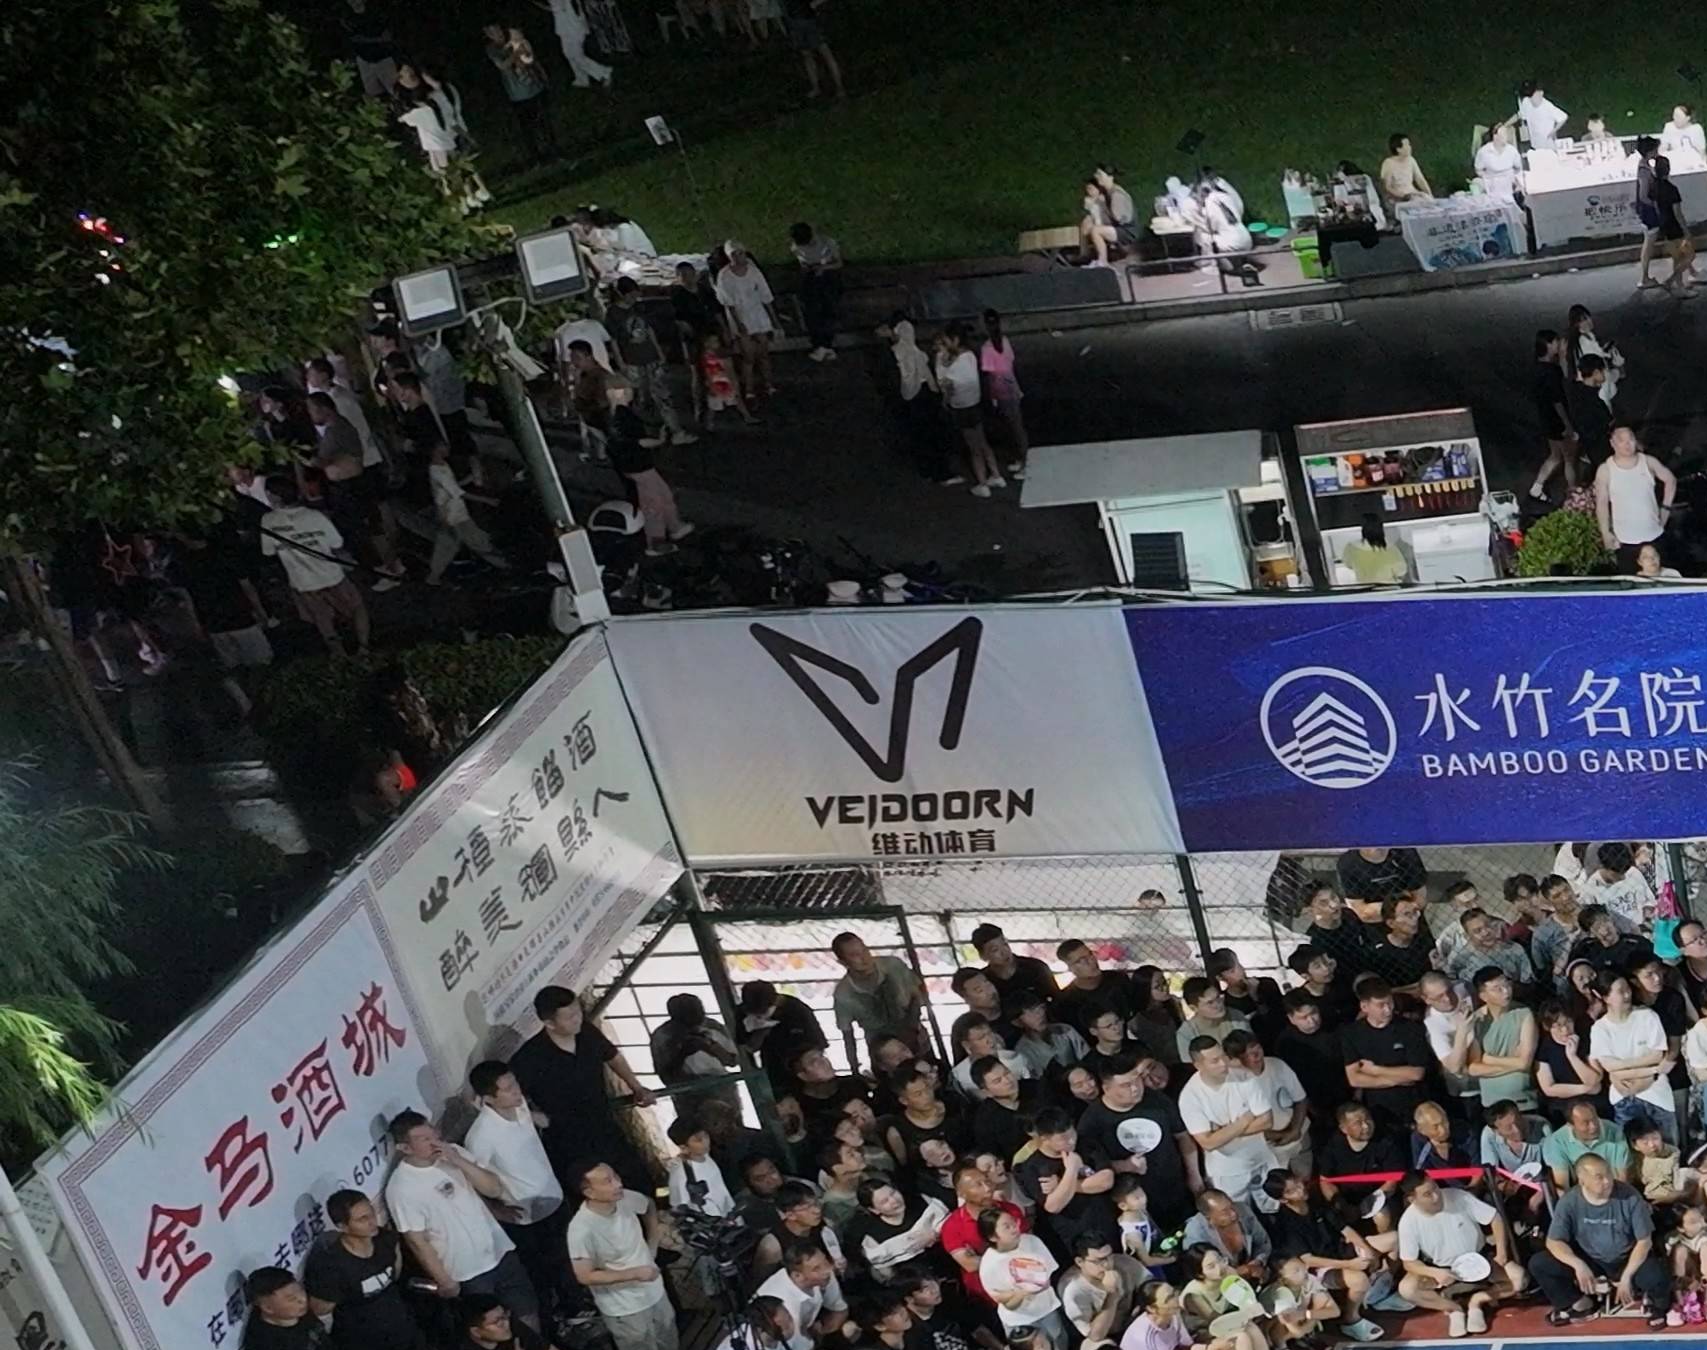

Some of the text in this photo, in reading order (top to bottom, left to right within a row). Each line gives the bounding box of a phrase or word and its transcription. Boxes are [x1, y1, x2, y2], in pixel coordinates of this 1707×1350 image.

[1422, 751, 1568, 779] BAMBOO
[870, 827, 998, 855] 维动体育
[135, 980, 407, 1307] 金马酒城
